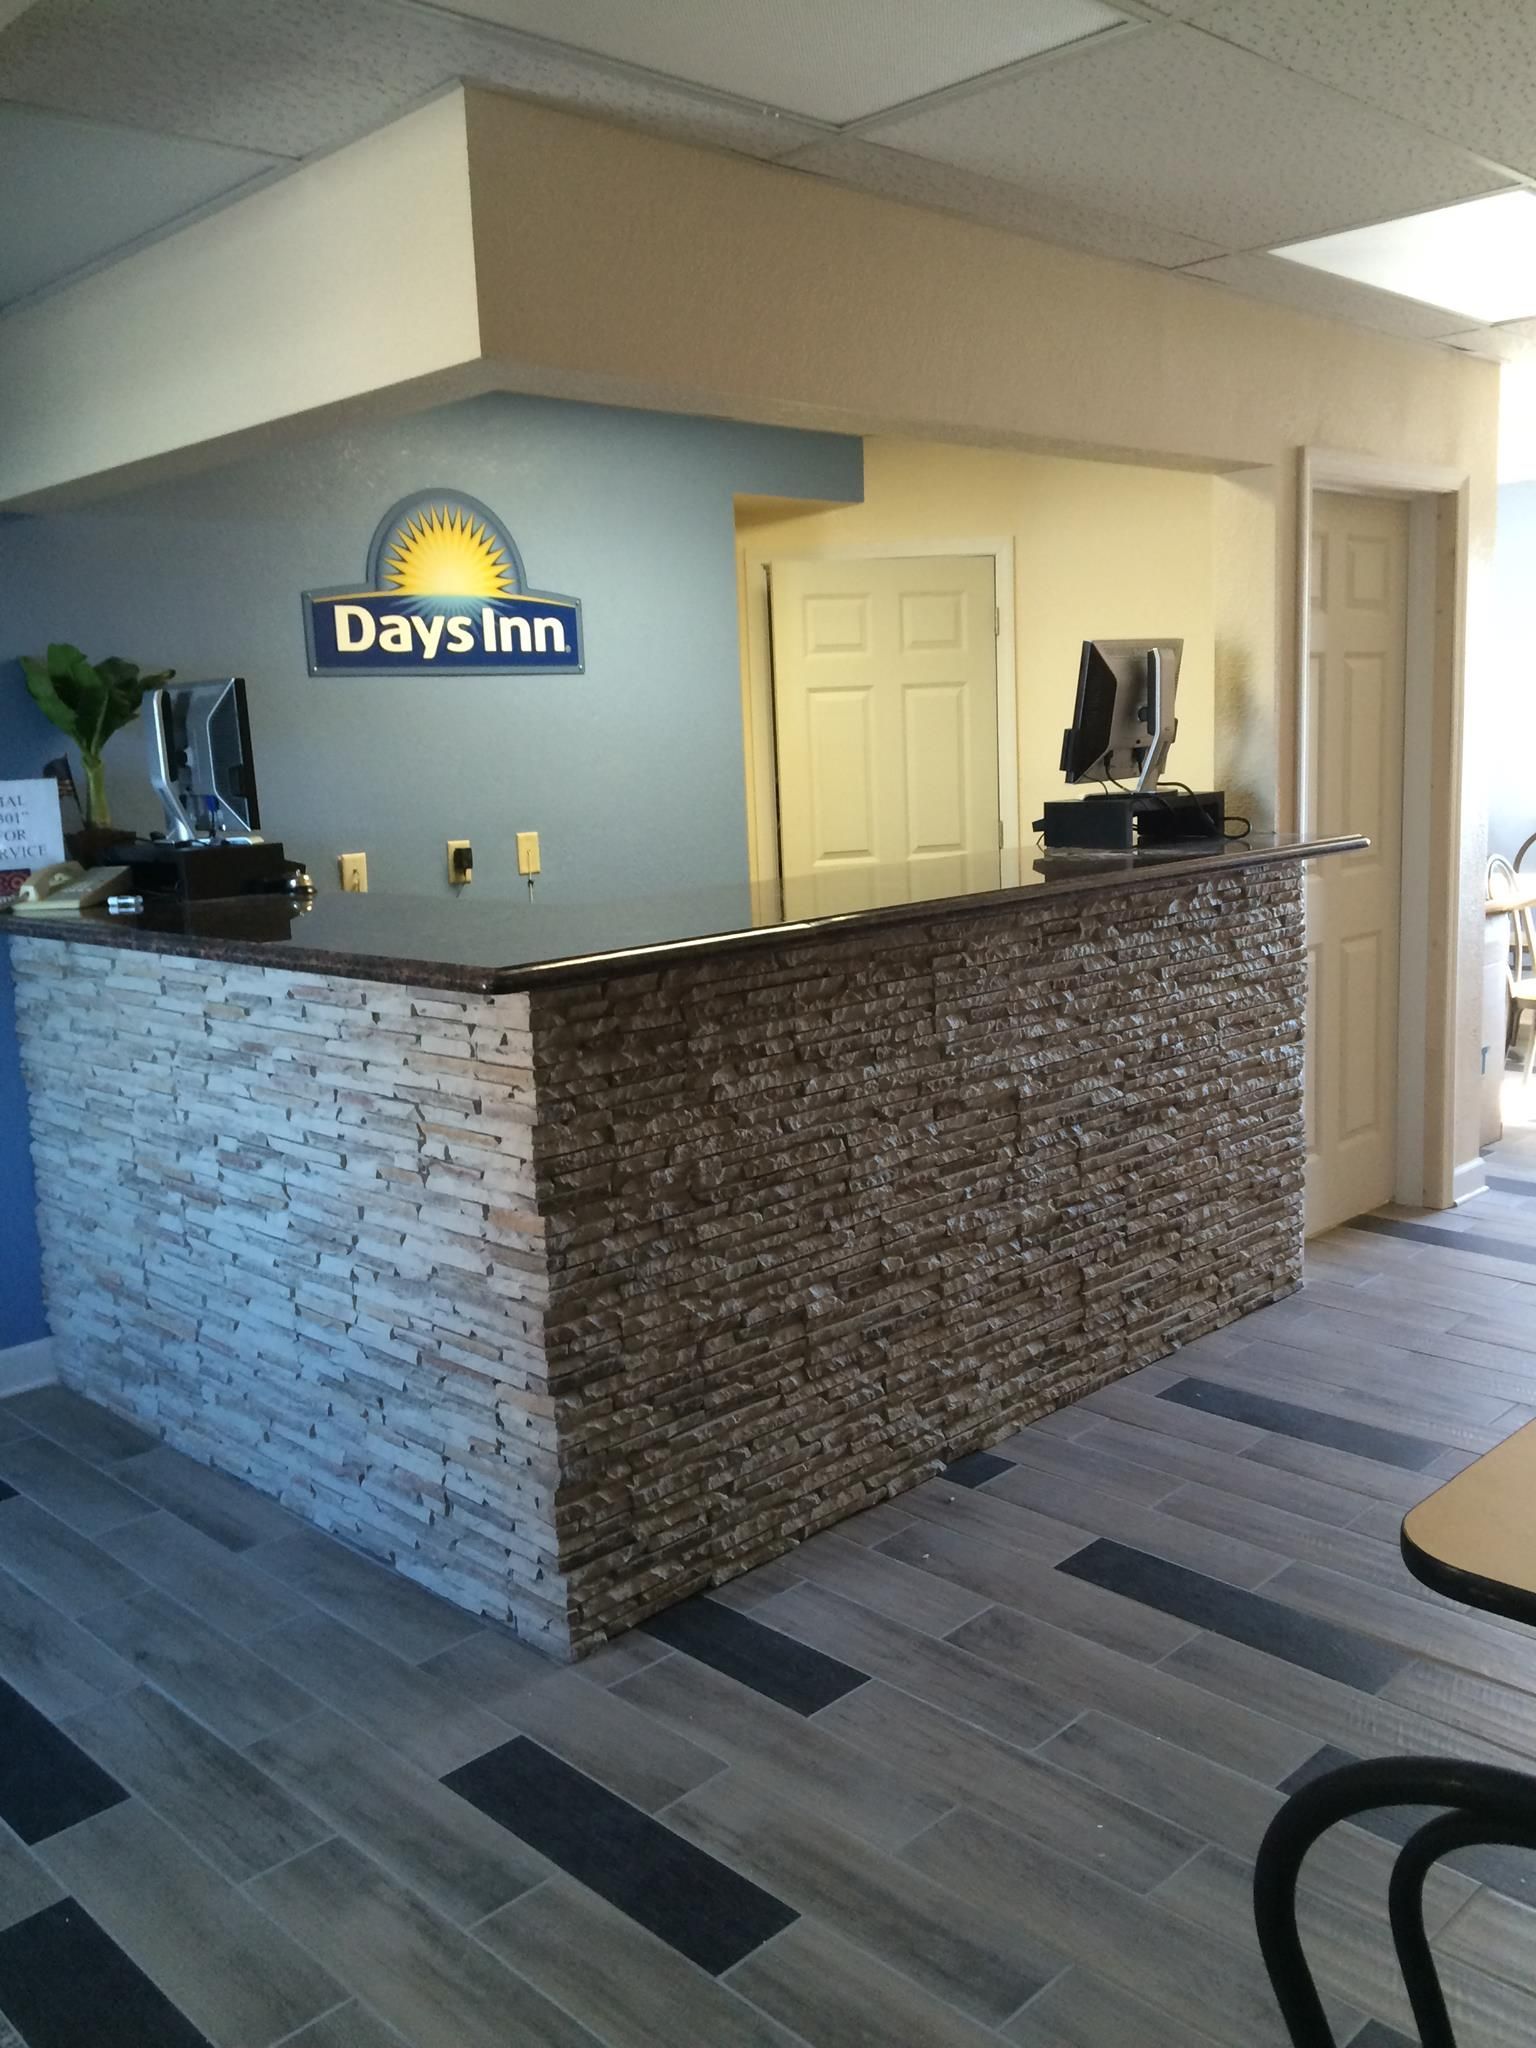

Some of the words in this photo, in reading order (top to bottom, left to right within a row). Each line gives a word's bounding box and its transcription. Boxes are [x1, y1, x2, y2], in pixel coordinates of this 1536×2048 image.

[334, 605, 475, 659] Days
[482, 607, 566, 652] Inn
[0, 830, 26, 841] OR
